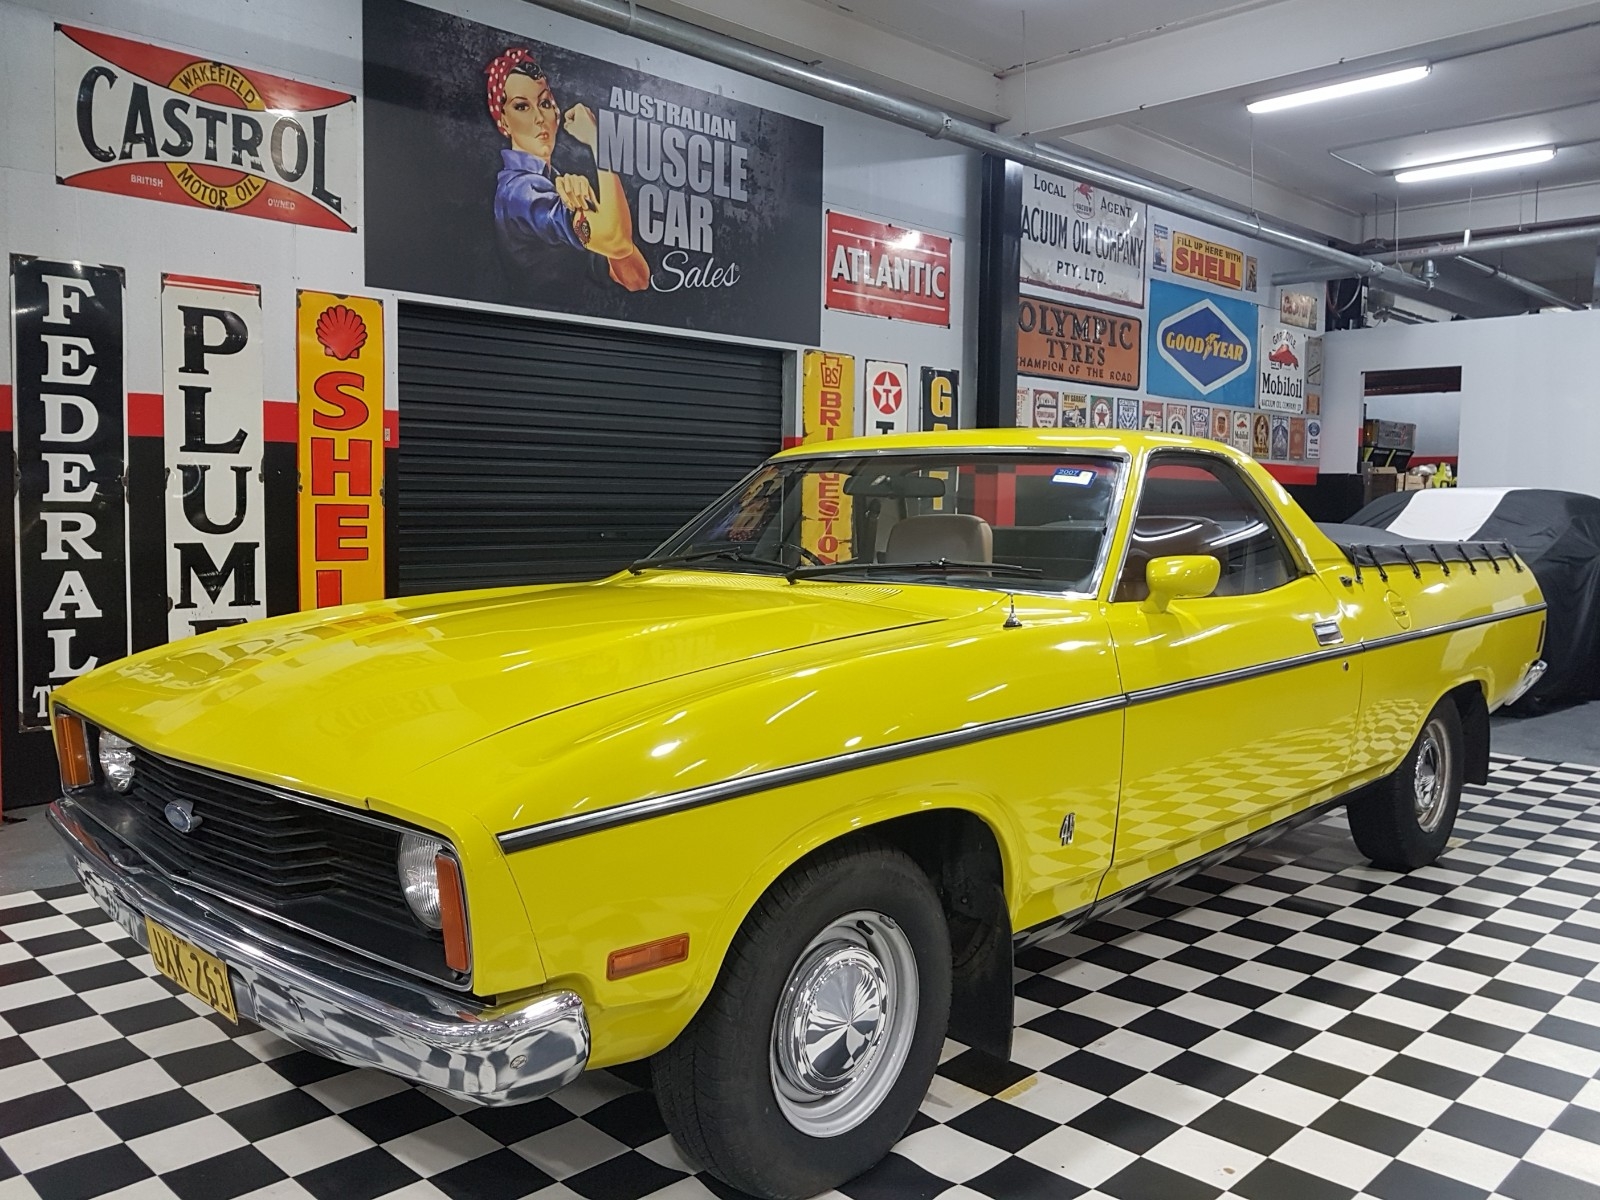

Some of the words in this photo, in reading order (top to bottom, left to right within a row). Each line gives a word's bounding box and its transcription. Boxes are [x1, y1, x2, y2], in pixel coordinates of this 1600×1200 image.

[179, 64, 256, 104] WAKEFIELD
[609, 86, 737, 142] AUSTRALIAN
[76, 66, 342, 214] CASTROL
[598, 108, 748, 202] MUSCLE
[130, 173, 164, 188] BRITISH
[177, 167, 229, 207] MOTOR
[235, 178, 260, 202] OIL
[1033, 173, 1067, 199] LOCAL
[1100, 196, 1132, 218] AGENT
[267, 197, 296, 211] OWNED
[638, 183, 713, 254] CAR
[1020, 204, 1068, 250] ACUUM
[1072, 219, 1091, 256] OIL
[1095, 225, 1143, 269] COMPANY
[1177, 236, 1192, 248] FILL
[1194, 241, 1204, 251] UP
[1204, 245, 1224, 258] HERE
[1225, 250, 1242, 263] WITH
[650, 250, 741, 292] Sales
[831, 244, 946, 299] ATLANTIC
[1084, 267, 1107, 285] LTD.
[1175, 246, 1241, 287] SHELL
[1018, 300, 1133, 350] OLYMPIC
[1272, 330, 1297, 350] GAROYLE
[1018, 356, 1065, 373] HAMPION
[1068, 364, 1080, 375] OF
[1086, 366, 1104, 379] THE
[1109, 370, 1132, 382] ROAD
[1046, 338, 1105, 367] TYRES
[823, 367, 840, 386] BS
[1261, 371, 1303, 399] Mobiloil
[39, 273, 103, 679] FEDERAL
[173, 304, 261, 634] PLUM
